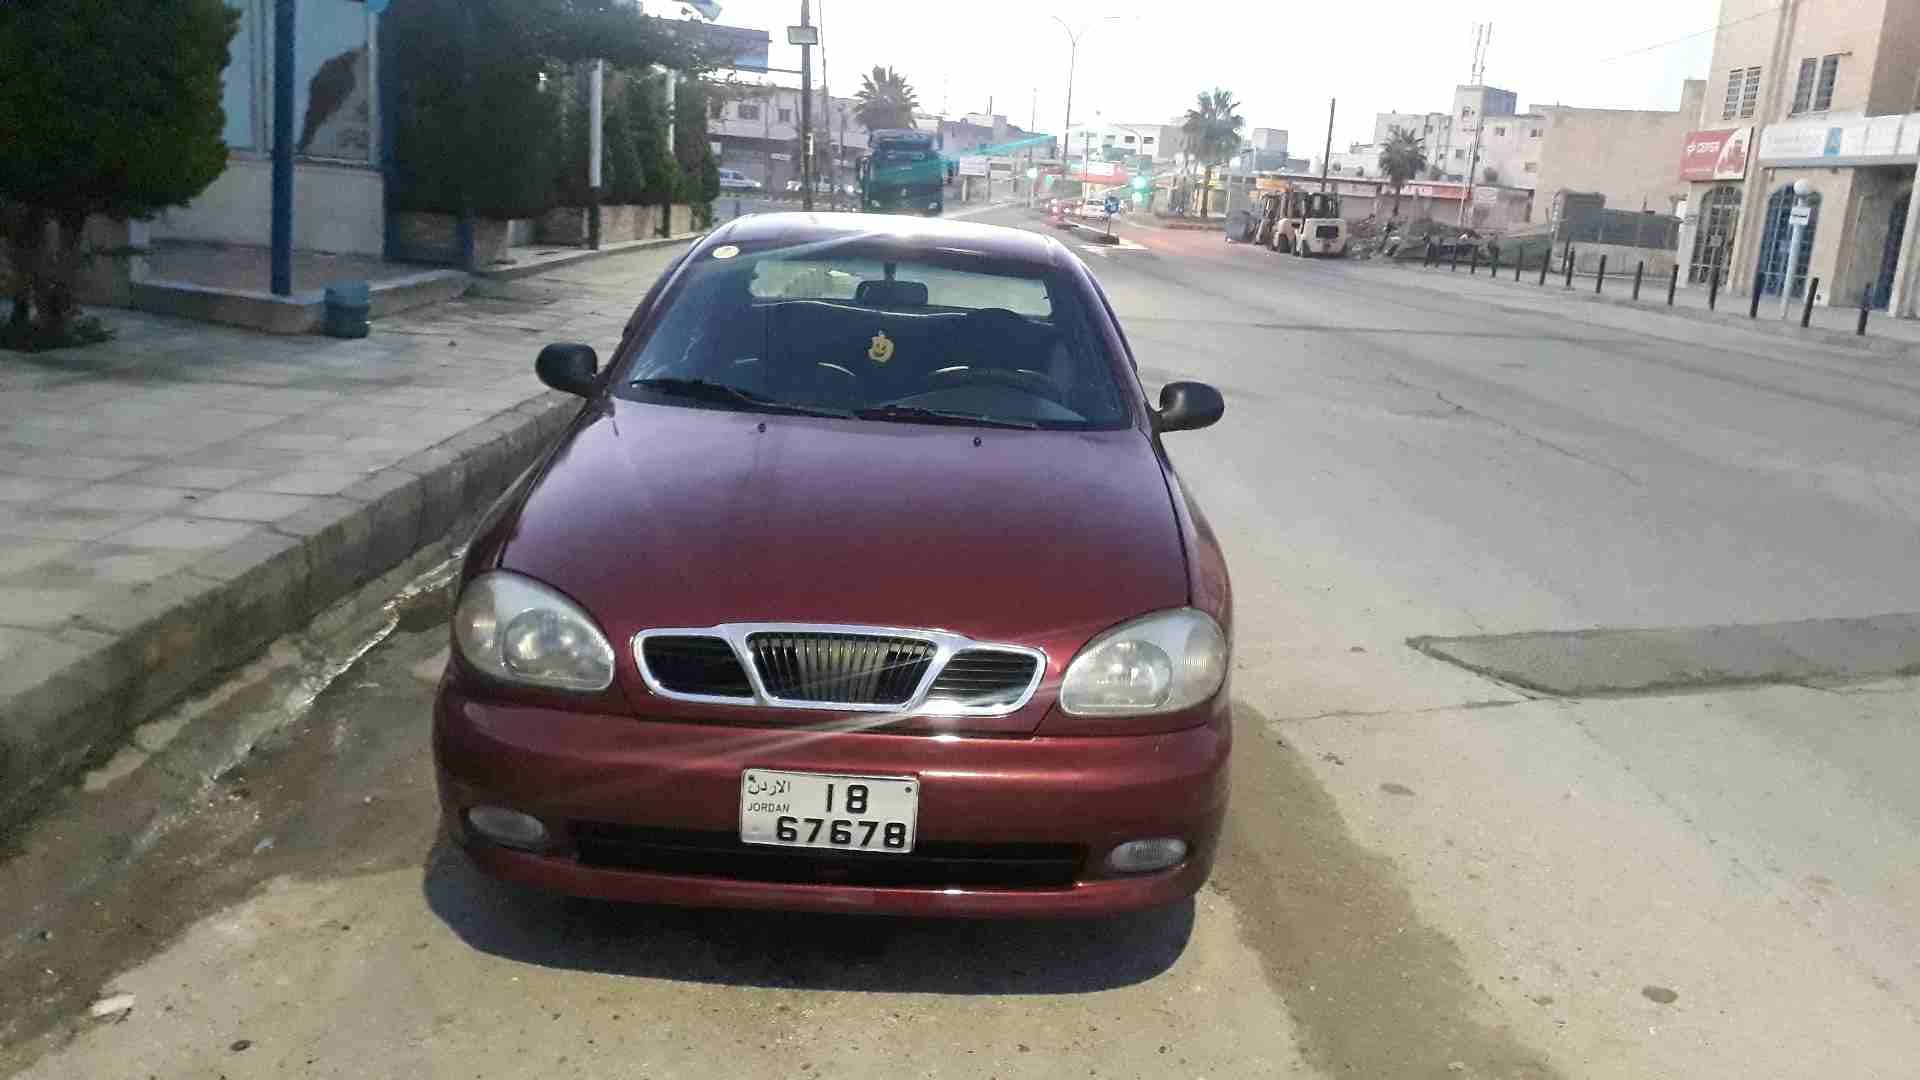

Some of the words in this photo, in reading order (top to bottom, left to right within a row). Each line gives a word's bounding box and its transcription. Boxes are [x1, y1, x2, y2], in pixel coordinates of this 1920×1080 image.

[747, 802, 790, 813] JORDAN
[826, 783, 869, 814] 18
[776, 815, 907, 849] 67678
